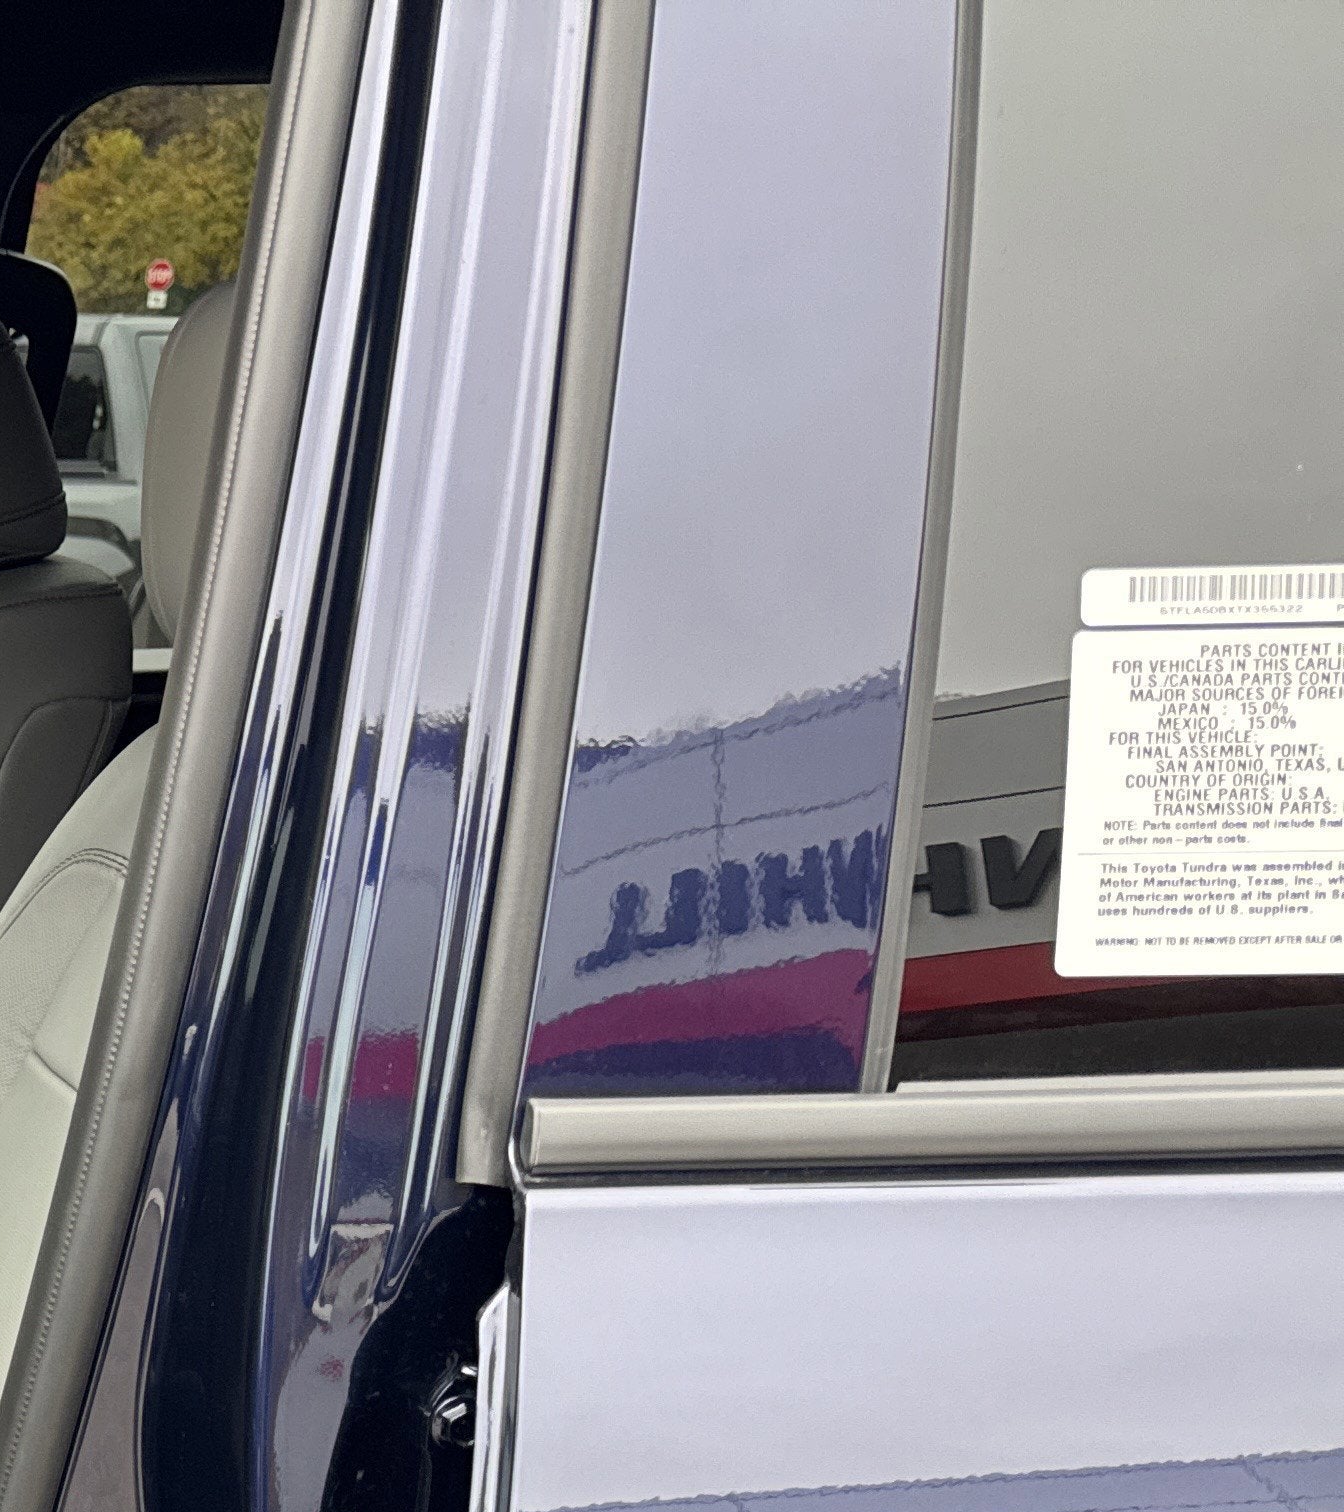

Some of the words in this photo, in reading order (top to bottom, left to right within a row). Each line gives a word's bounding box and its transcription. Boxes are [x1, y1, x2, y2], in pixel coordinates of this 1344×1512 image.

[1201, 644, 1251, 657] PARTS
[1258, 643, 1331, 656] CONTENT
[1112, 660, 1143, 673] FOR
[1150, 660, 1224, 673] VEHICLES
[1231, 659, 1246, 671] IN
[1254, 659, 1289, 671] THIS
[1241, 672, 1292, 685] PARTS
[1130, 689, 1185, 702] MAJOR
[1192, 688, 1265, 701] SOURCES
[1271, 687, 1291, 700] OF
[1159, 703, 1210, 716] JAPAN
[1158, 717, 1218, 730] MEXICO
[1249, 716, 1297, 729] 15.0%
[1109, 732, 1139, 745] FOR
[1146, 732, 1181, 744] THIS
[1188, 730, 1258, 744] VEHICLE:
[1128, 746, 1172, 759] FINAL
[1179, 745, 1264, 758] ASSEMBLY
[1271, 743, 1323, 757] POINT:
[1156, 760, 1187, 773] SAN
[1194, 759, 1268, 773] ANTONIO,
[1277, 757, 1331, 772] TEXAS,
[1125, 775, 1200, 788] COUNTRY
[1207, 775, 1227, 787] OF
[1233, 773, 1292, 787] ORIGIN:
[1154, 788, 1211, 802] ENGINE
[1219, 788, 1274, 801] PARTS:
[1152, 803, 1273, 816] TRANSMISSION
[1280, 801, 1337, 815] PARTS:
[1143, 821, 1171, 830] Parts
[1175, 820, 1217, 830] content
[1222, 820, 1247, 829] does
[1253, 820, 1270, 829] not
[1274, 819, 1314, 828] include
[1103, 837, 1114, 845] or
[1119, 836, 1147, 845] other
[1101, 863, 1128, 873] This
[1133, 863, 1177, 875] Toyota
[1182, 862, 1227, 872] Tundra
[1232, 863, 1257, 872] was
[1262, 861, 1332, 872] assembled
[1100, 877, 1138, 888] Motor
[1144, 877, 1241, 888] Manufacturing,
[1248, 876, 1288, 886] Texas,
[1099, 893, 1112, 902] of
[1116, 892, 1178, 902] American
[1184, 892, 1235, 901] workers
[1241, 891, 1253, 901] at
[1257, 891, 1272, 900] its
[1277, 890, 1310, 902] plant
[1315, 890, 1326, 900] in
[1098, 908, 1127, 917] uses
[1133, 907, 1193, 916] hundreds
[1198, 906, 1210, 916] of
[1249, 904, 1313, 917] suppliers.
[1166, 937, 1176, 945] TO
[1193, 936, 1236, 945] REMOVED
[1239, 936, 1271, 944] EXCEPT
[1275, 935, 1302, 944] AFTER
